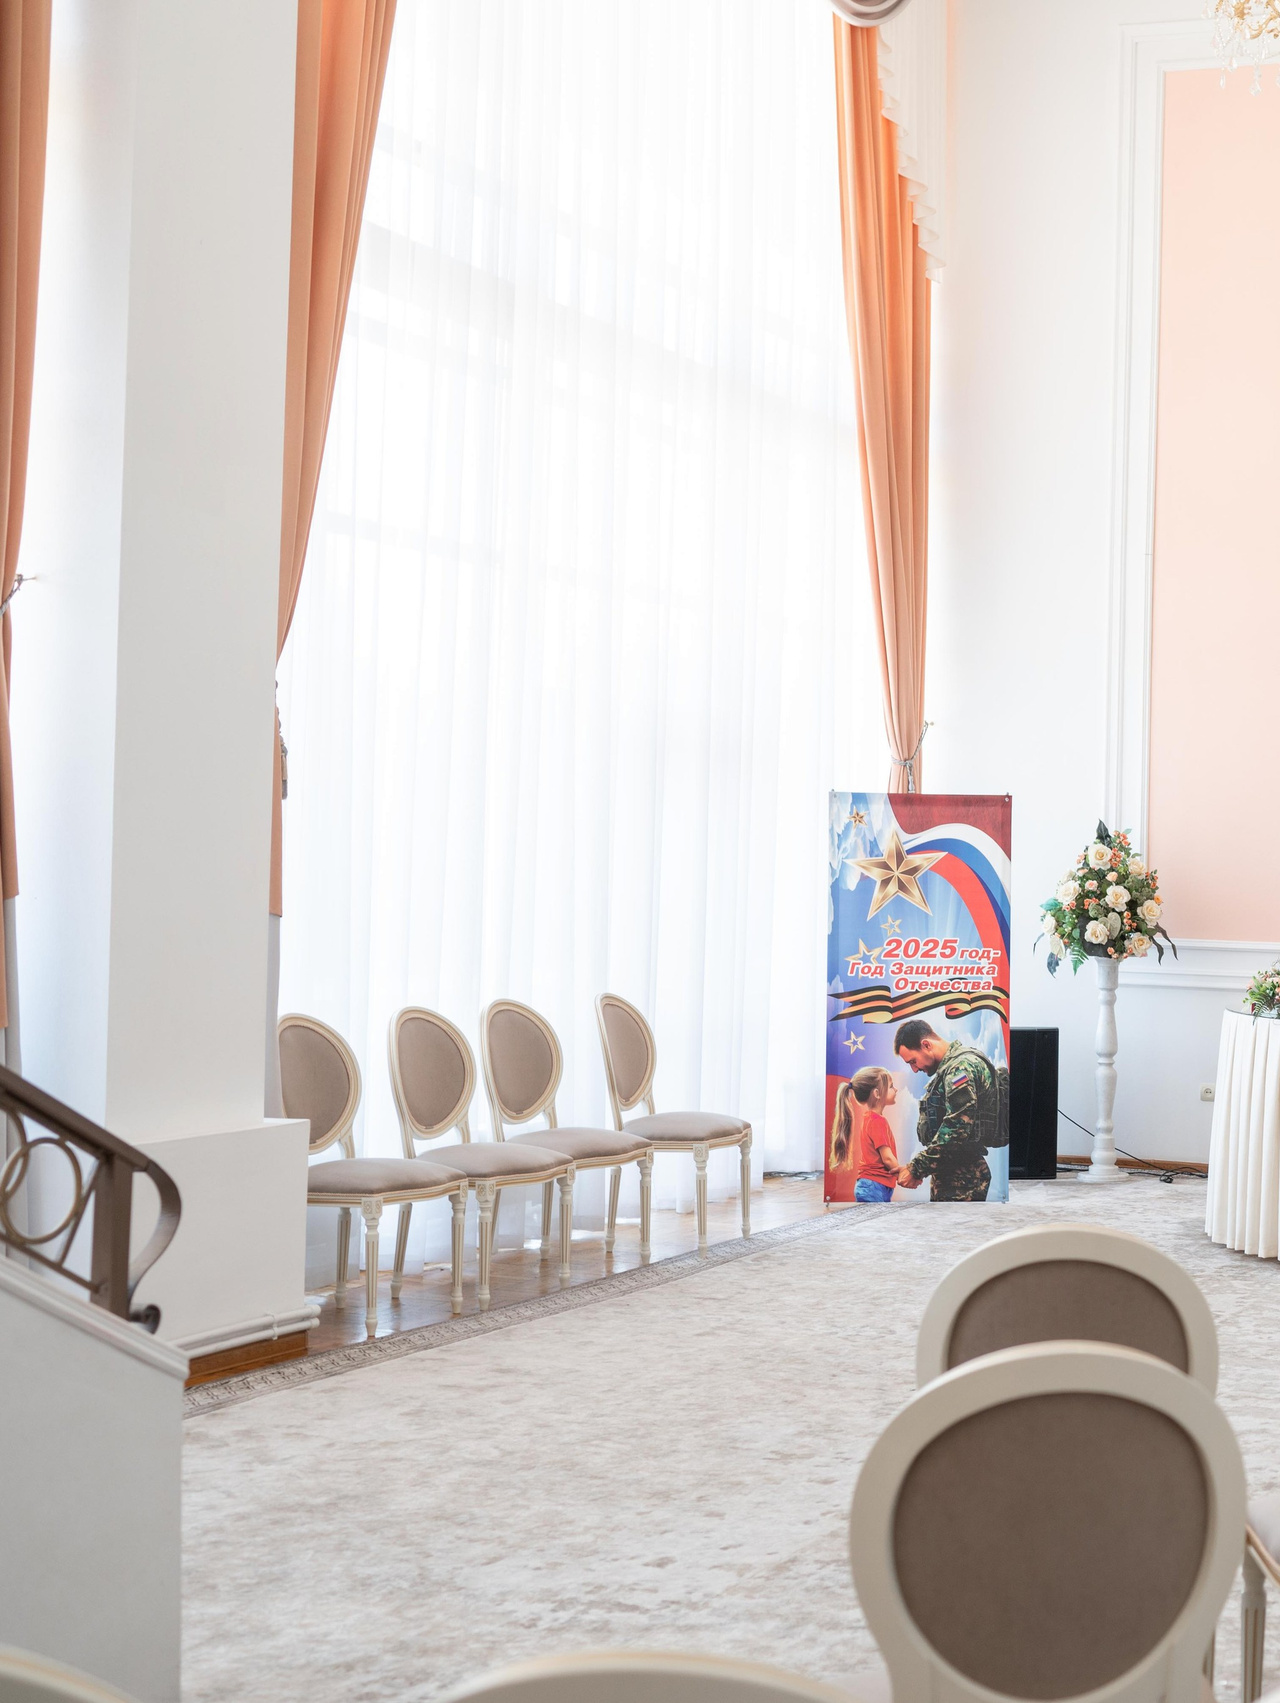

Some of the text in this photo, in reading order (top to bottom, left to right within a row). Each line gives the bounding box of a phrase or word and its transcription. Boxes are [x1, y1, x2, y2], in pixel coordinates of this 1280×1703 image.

[882, 938, 958, 959] 2025
[849, 962, 996, 977] Год Защитника
[894, 979, 992, 991] Отечества
